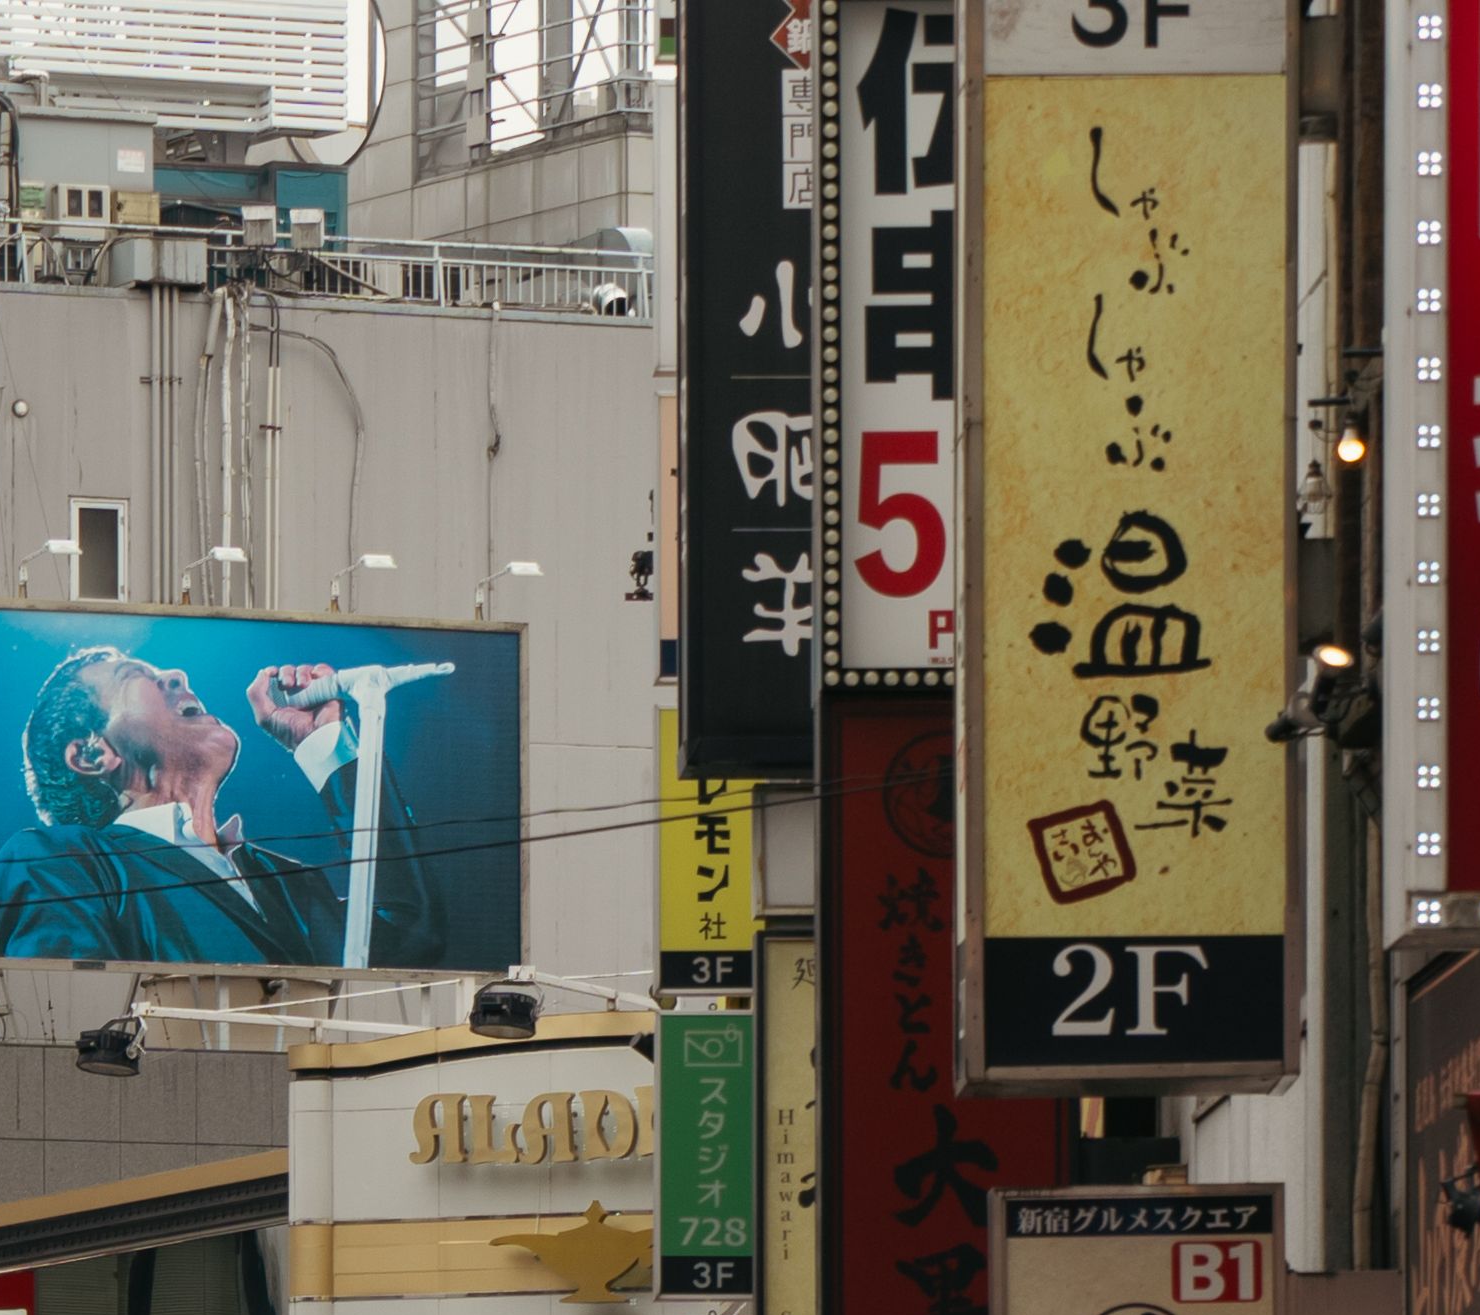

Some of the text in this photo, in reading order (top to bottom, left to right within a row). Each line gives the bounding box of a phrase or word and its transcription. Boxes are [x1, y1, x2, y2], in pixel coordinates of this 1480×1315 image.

[1085, 127, 1190, 472] しゃぶしゃぶ
[691, 956, 734, 985] 3F
[876, 864, 945, 1093] 焼きとん
[1050, 943, 1210, 1038] 2F
[697, 1077, 729, 1206] スタジオ
[777, 1107, 795, 1263] Himawari
[1017, 1204, 1259, 1235] 新宿グルメスクエア
[679, 1216, 747, 1247] 728
[692, 1262, 735, 1289] 3F
[1178, 1242, 1256, 1301] B1
